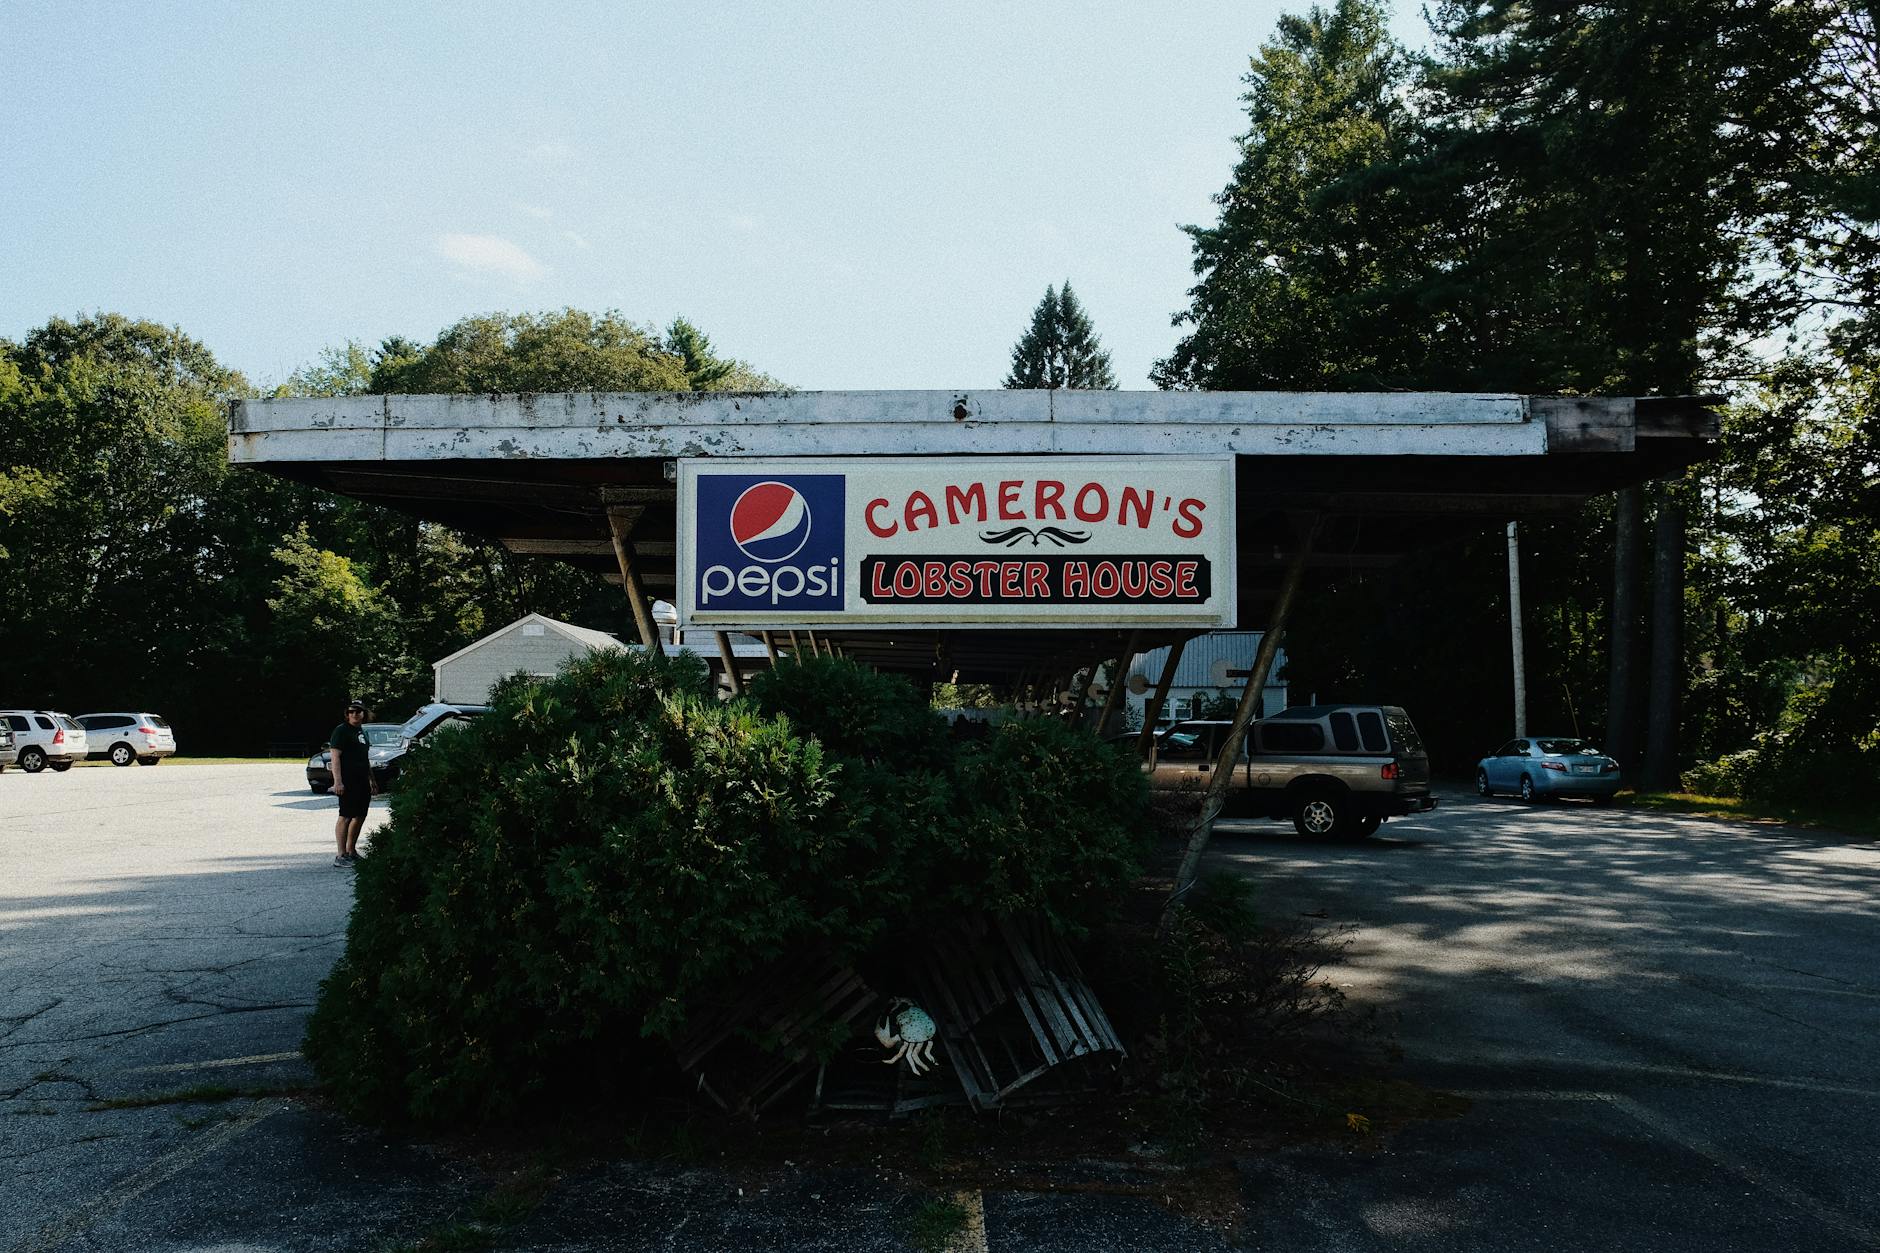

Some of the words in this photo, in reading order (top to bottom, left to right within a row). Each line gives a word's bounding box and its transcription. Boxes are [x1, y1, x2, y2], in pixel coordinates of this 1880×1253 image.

[865, 480, 1206, 538] CAMERON'S
[702, 557, 839, 605] pepsi
[871, 560, 1051, 598] LOBSTER
[1062, 560, 1200, 598] HOUSE
